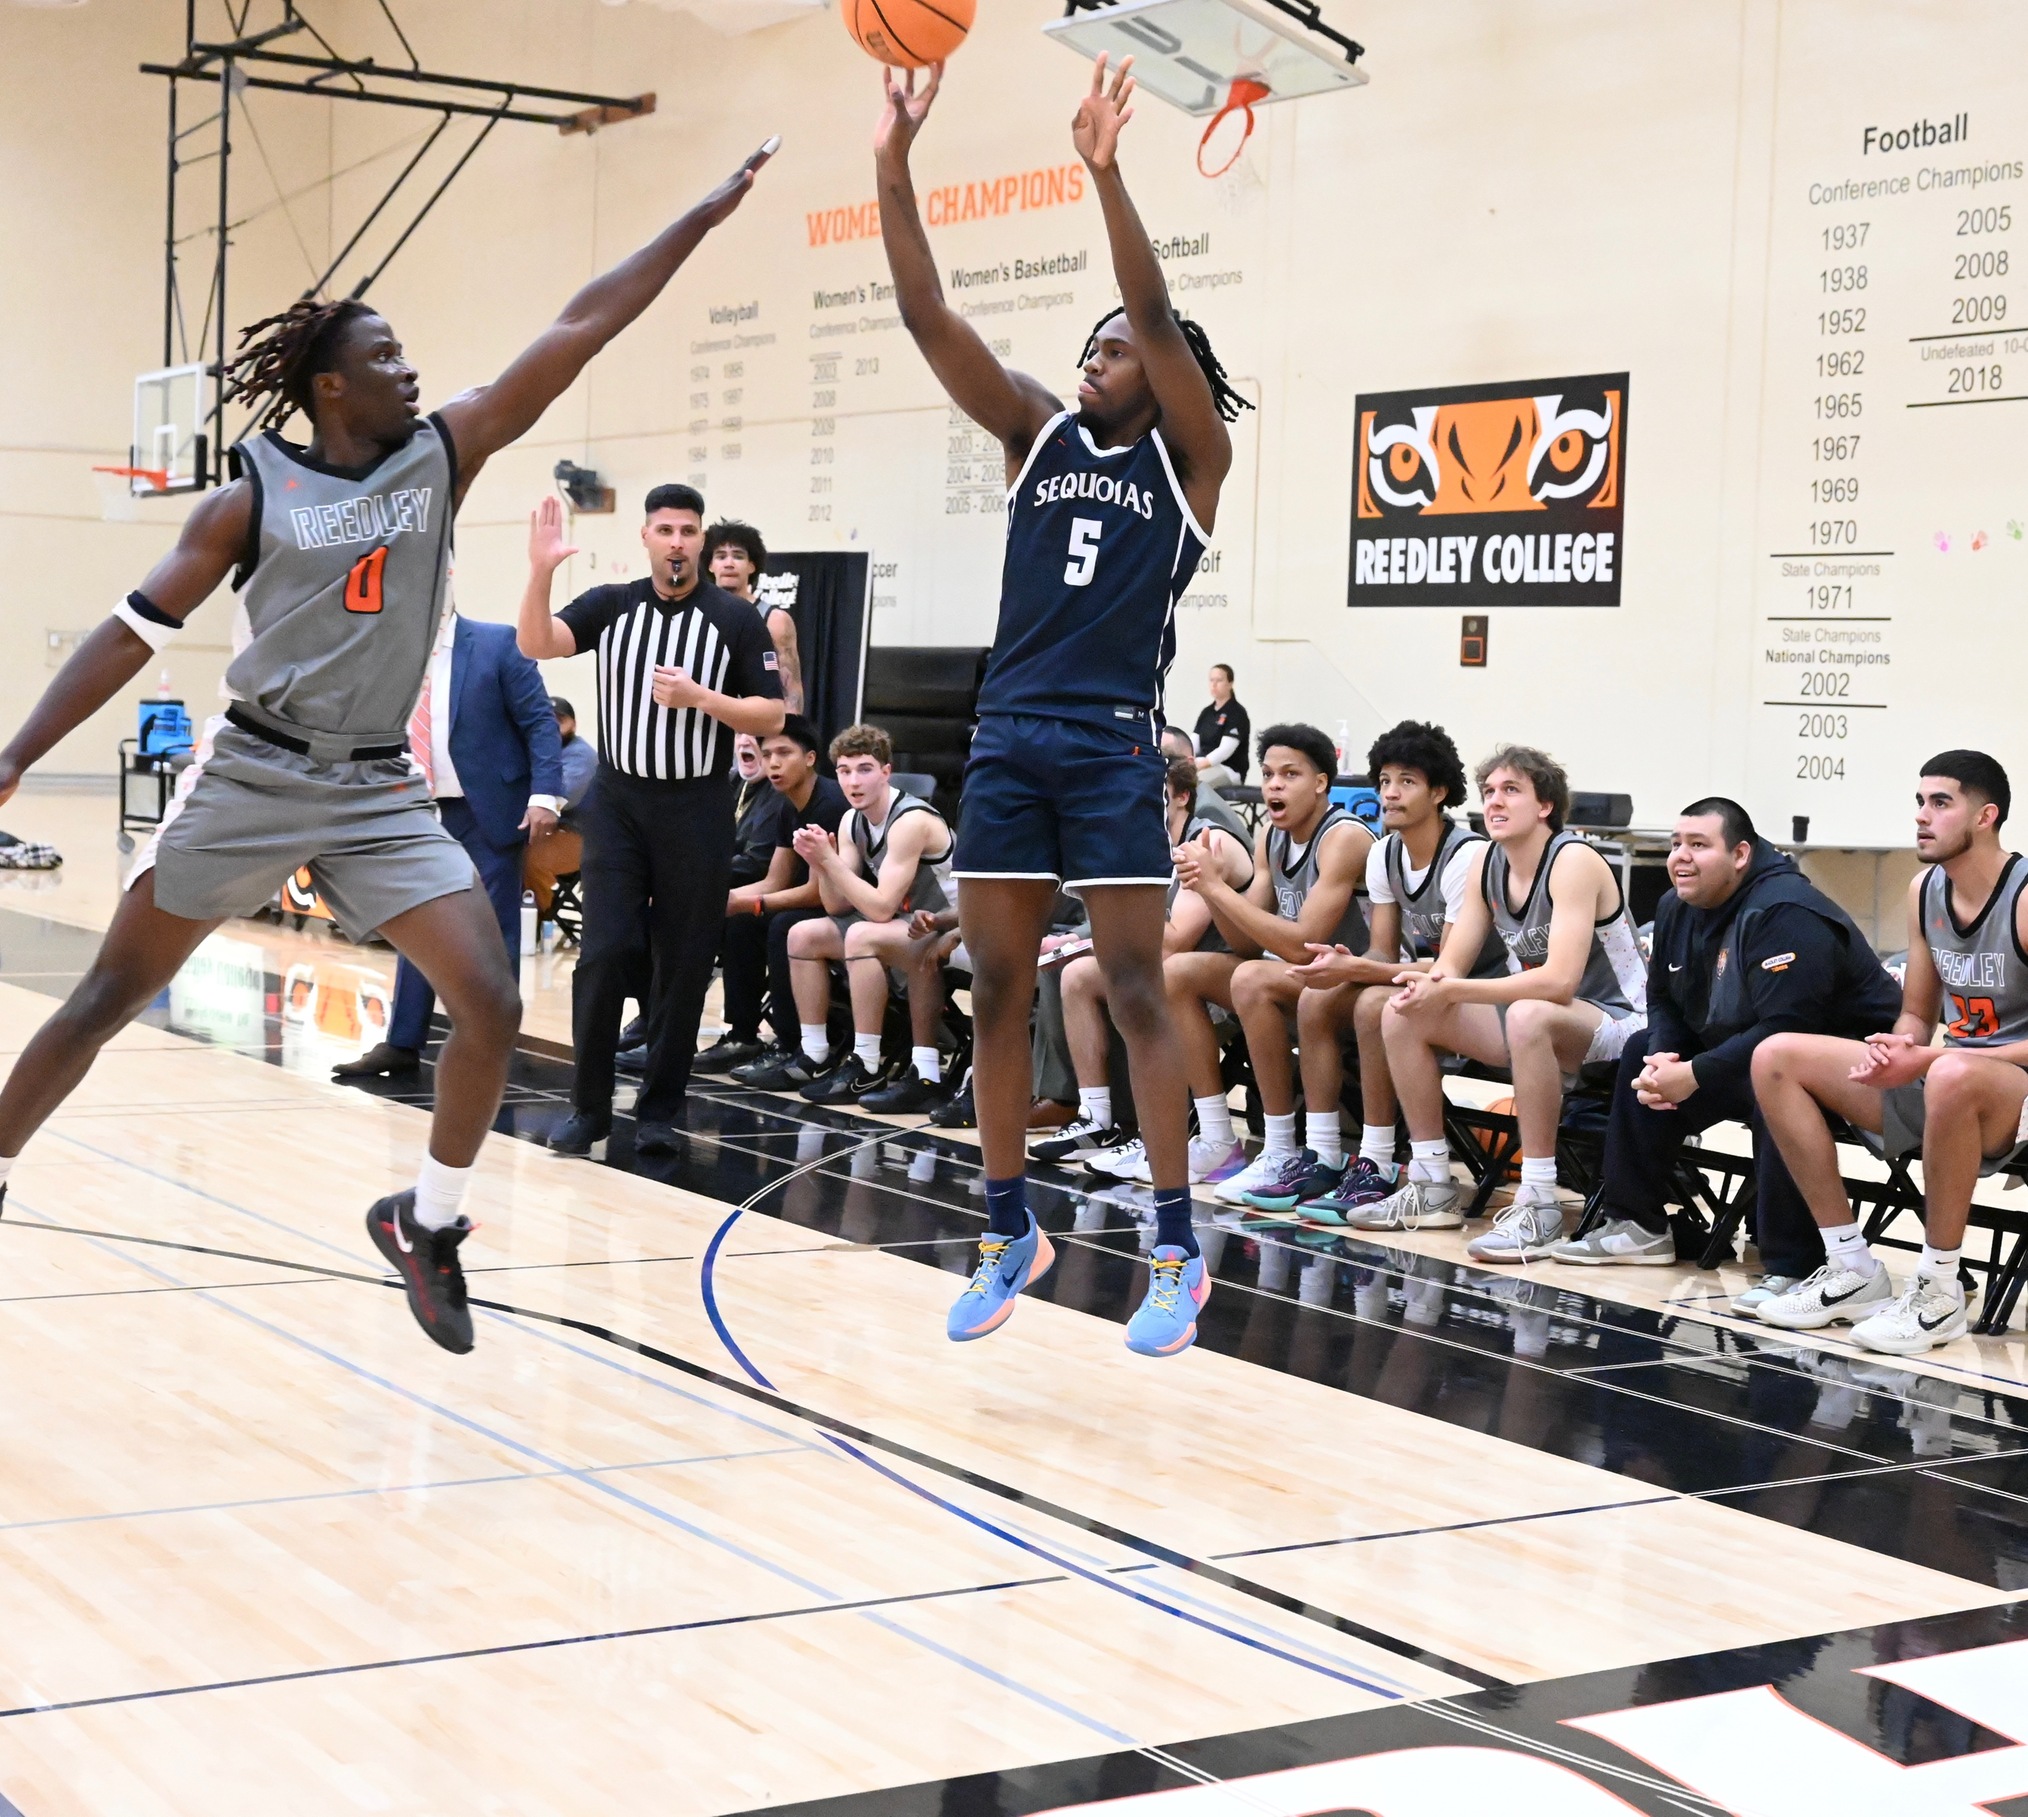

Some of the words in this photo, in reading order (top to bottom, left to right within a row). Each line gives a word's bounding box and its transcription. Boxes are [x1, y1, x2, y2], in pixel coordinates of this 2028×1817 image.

[1863, 113, 1968, 155] Football
[1809, 175, 1911, 206] Conference
[1917, 160, 2023, 190] Champions
[807, 196, 919, 247] WOME
[927, 164, 1085, 227] CHAMPIONS
[1956, 205, 2011, 236] 2005
[1822, 222, 1870, 251] 1937
[950, 262, 1010, 289] Women's
[1014, 249, 1087, 281] Basketball
[1954, 250, 2009, 280] 2008
[1178, 269, 1243, 291] Champions
[1819, 265, 1868, 293] 1938
[813, 284, 866, 310] Women's
[960, 298, 1015, 318] Conference
[1017, 291, 1074, 311] Champions
[1952, 294, 2007, 324] 2009
[708, 300, 759, 327] Volleyball
[1818, 307, 1867, 335] 1952
[1816, 350, 1865, 378] 1962
[1921, 340, 1995, 361] Undefeated
[1948, 364, 2002, 393] 2018
[1814, 392, 1863, 419] 1965
[810, 446, 834, 465] 2010
[1812, 435, 1860, 461] 1967
[810, 476, 833, 494] 2011
[946, 466, 971, 484] 2004
[1033, 472, 1154, 520] SEQUOIAS
[1810, 477, 1859, 503] 1969
[289, 487, 433, 551] REEDLEY
[808, 505, 832, 522] 2012
[1809, 519, 1857, 545] 1970
[1063, 516, 1103, 586] 5
[1355, 536, 1478, 585] REEDLEY
[1482, 532, 1615, 584] COLLEGE
[343, 545, 390, 614] 0
[873, 562, 898, 578] ccer
[1782, 562, 1811, 577] State
[1814, 562, 1880, 579] Champions
[1179, 594, 1228, 611] ampions
[1806, 585, 1853, 610] 1971
[1782, 628, 1811, 643] State
[1815, 628, 1881, 645] Champions
[1765, 649, 1815, 664] National
[1819, 649, 1890, 666] Champions
[1800, 672, 1850, 697] 2002
[1798, 713, 1848, 739] 2003
[1796, 755, 1845, 780] 2004
[1948, 993, 2000, 1038] 23
